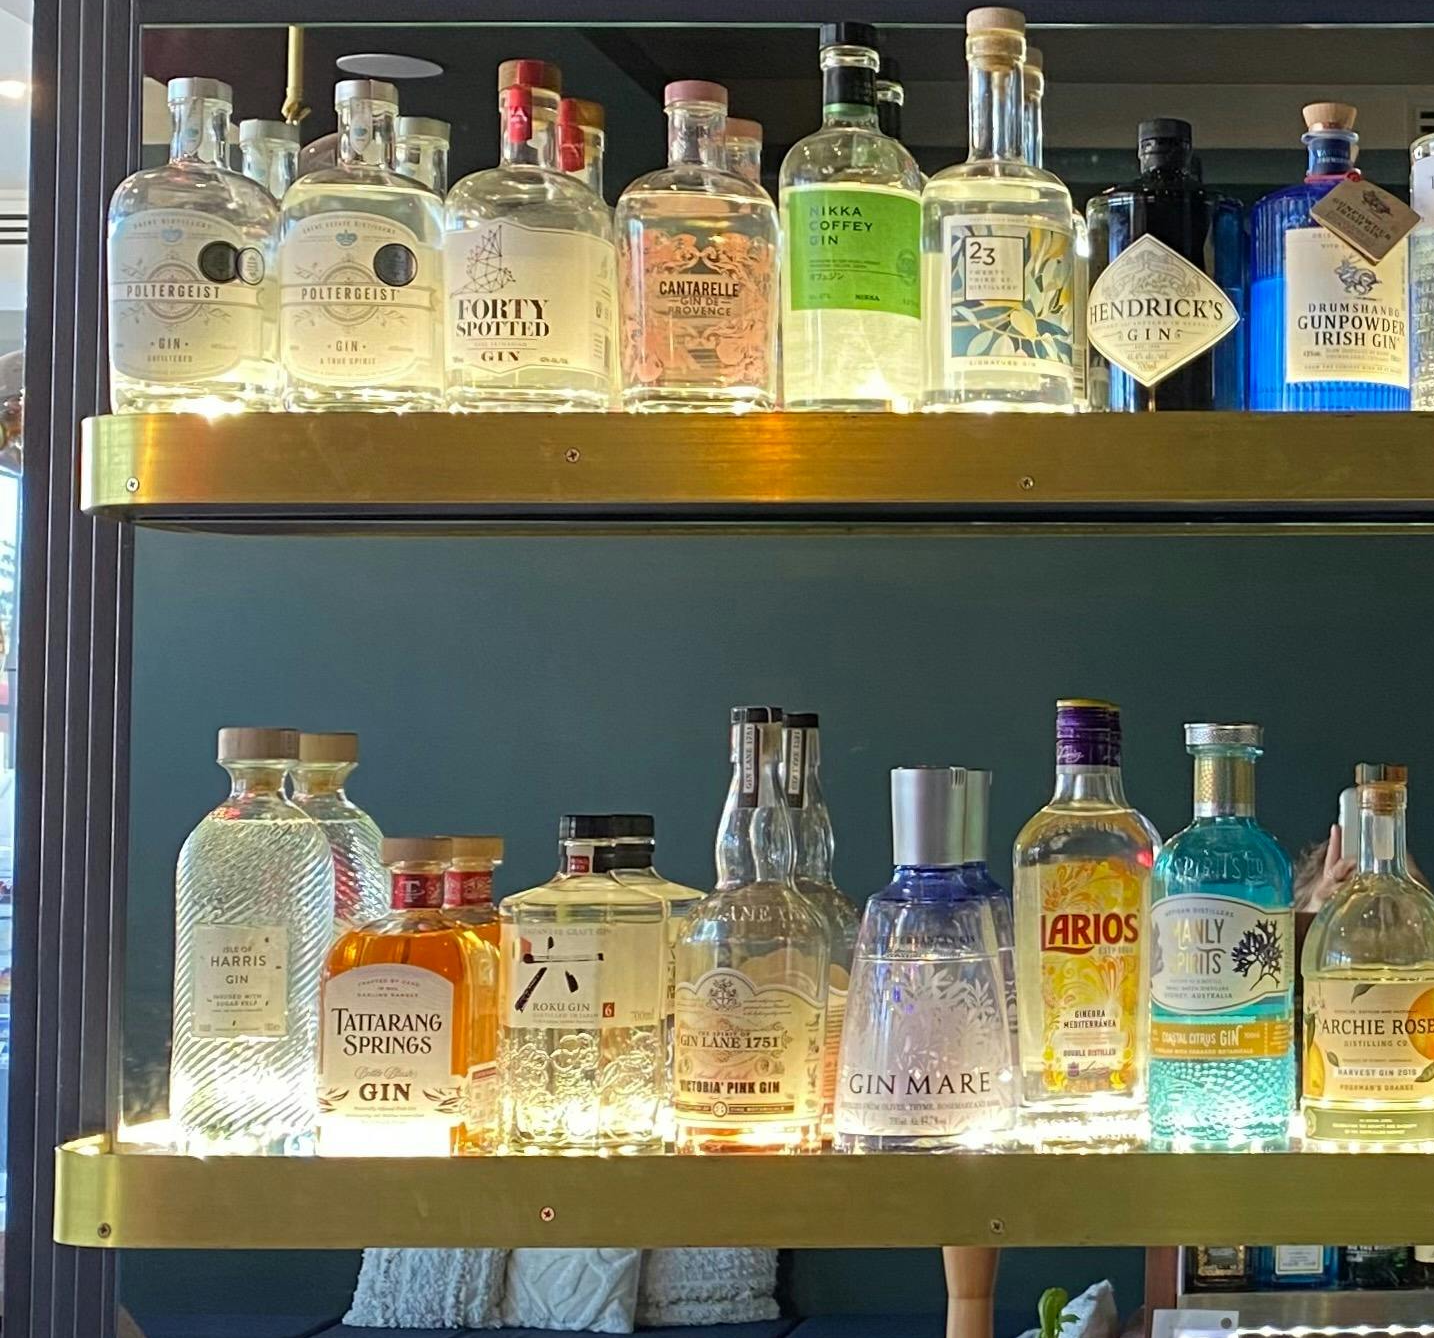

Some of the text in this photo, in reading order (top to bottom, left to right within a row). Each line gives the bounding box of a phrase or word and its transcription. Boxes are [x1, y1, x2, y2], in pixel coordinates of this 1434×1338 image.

[809, 207, 862, 217] NIKKA
[809, 222, 873, 231] COFFEY
[809, 235, 838, 245] GIN
[969, 241, 995, 266] 23
[127, 286, 220, 298] POLTERGEIST
[301, 286, 397, 301] POLTERGEIST
[659, 281, 740, 298] CANTARELLE
[680, 297, 719, 307] GIN DE
[458, 299, 549, 320] FORTY
[668, 307, 732, 317] PROVENCE
[1090, 298, 1223, 325] HENDRICK'S
[1308, 303, 1399, 318] DRUMSHANBO
[456, 321, 549, 337] SPOTTED
[1298, 315, 1405, 336] GUNPOWDER
[1128, 328, 1170, 341] GIN
[1315, 331, 1396, 350] IRISH GIN
[158, 338, 181, 350] GIN
[336, 341, 359, 352] GIN
[481, 351, 520, 362] GIN
[744, 744, 753, 772] LANE
[744, 773, 753, 791] GIN
[1040, 912, 1139, 954] LARIOS
[210, 955, 266, 967] HARRIS
[225, 975, 248, 984] GIN
[532, 1003, 591, 1011] ROKU GIN
[604, 1004, 612, 1017] 6
[1075, 1009, 1105, 1018] GINEBRA
[331, 1008, 442, 1035] TATTARANG
[1322, 1019, 1385, 1035] ARCHIE
[680, 1036, 778, 1049] GIN LANE 1751
[1189, 1025, 1242, 1046] CITRUS GIN
[343, 1035, 432, 1056] SPRINGS
[1338, 1068, 1376, 1076] HARVEST
[727, 1081, 780, 1094] PINK GIN
[849, 1072, 992, 1095] GIN MARE
[359, 1083, 411, 1101] GIN
